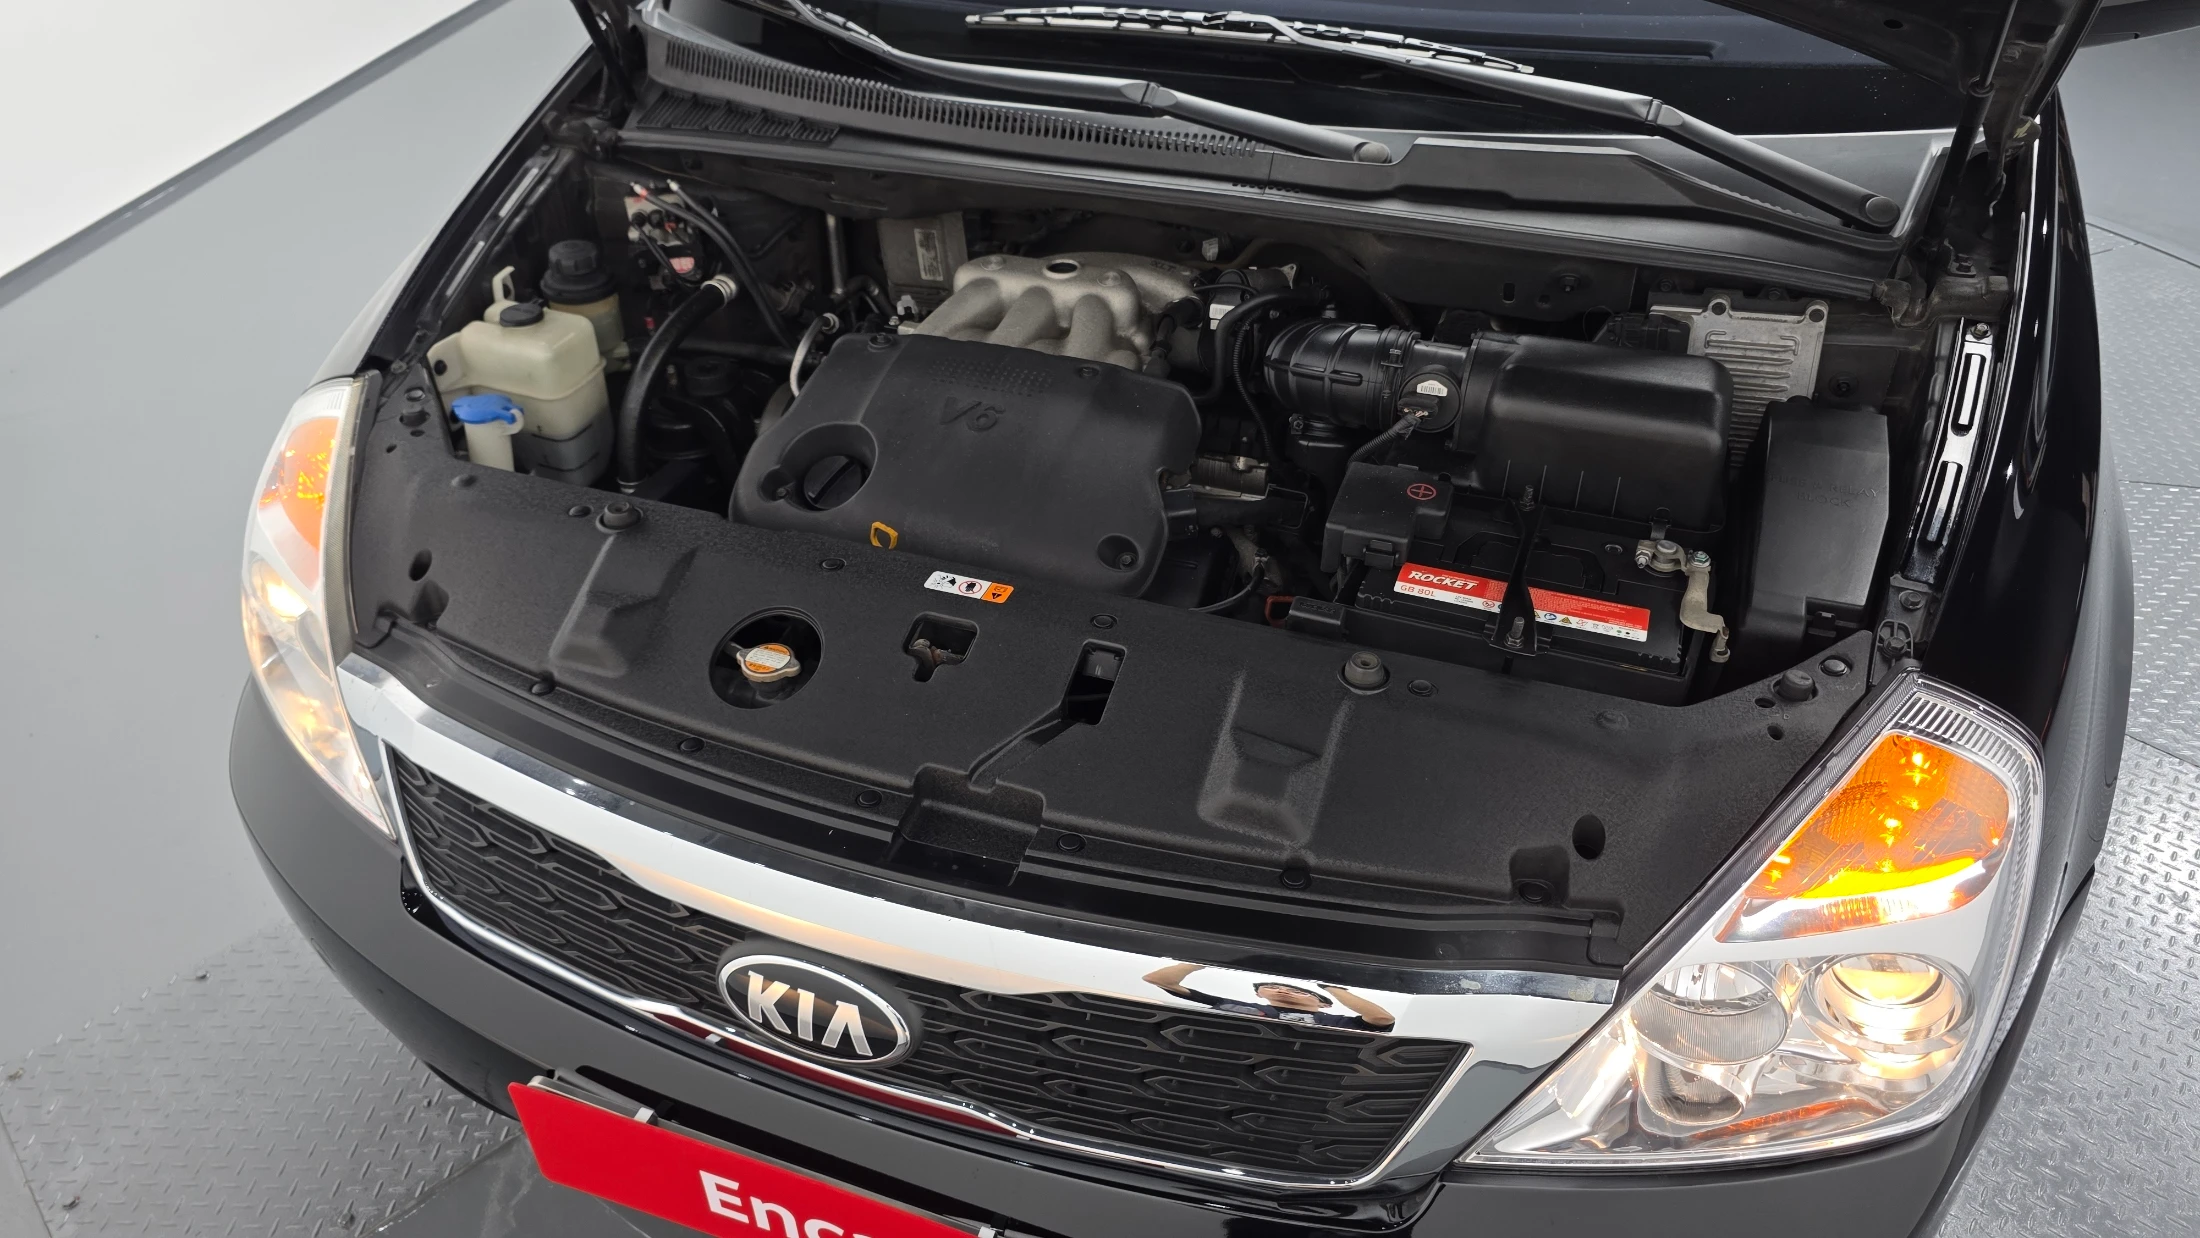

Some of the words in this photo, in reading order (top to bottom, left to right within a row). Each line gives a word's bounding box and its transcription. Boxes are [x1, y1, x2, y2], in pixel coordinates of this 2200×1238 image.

[940, 396, 1006, 432] V6
[1797, 491, 1850, 508] BLOCK
[1829, 483, 1879, 498] RELAY
[1407, 570, 1478, 590] ROCKET
[1400, 584, 1415, 593] GB
[1417, 588, 1436, 597] 80L
[748, 970, 873, 1057] KIA
[699, 1170, 873, 1238] Enc
